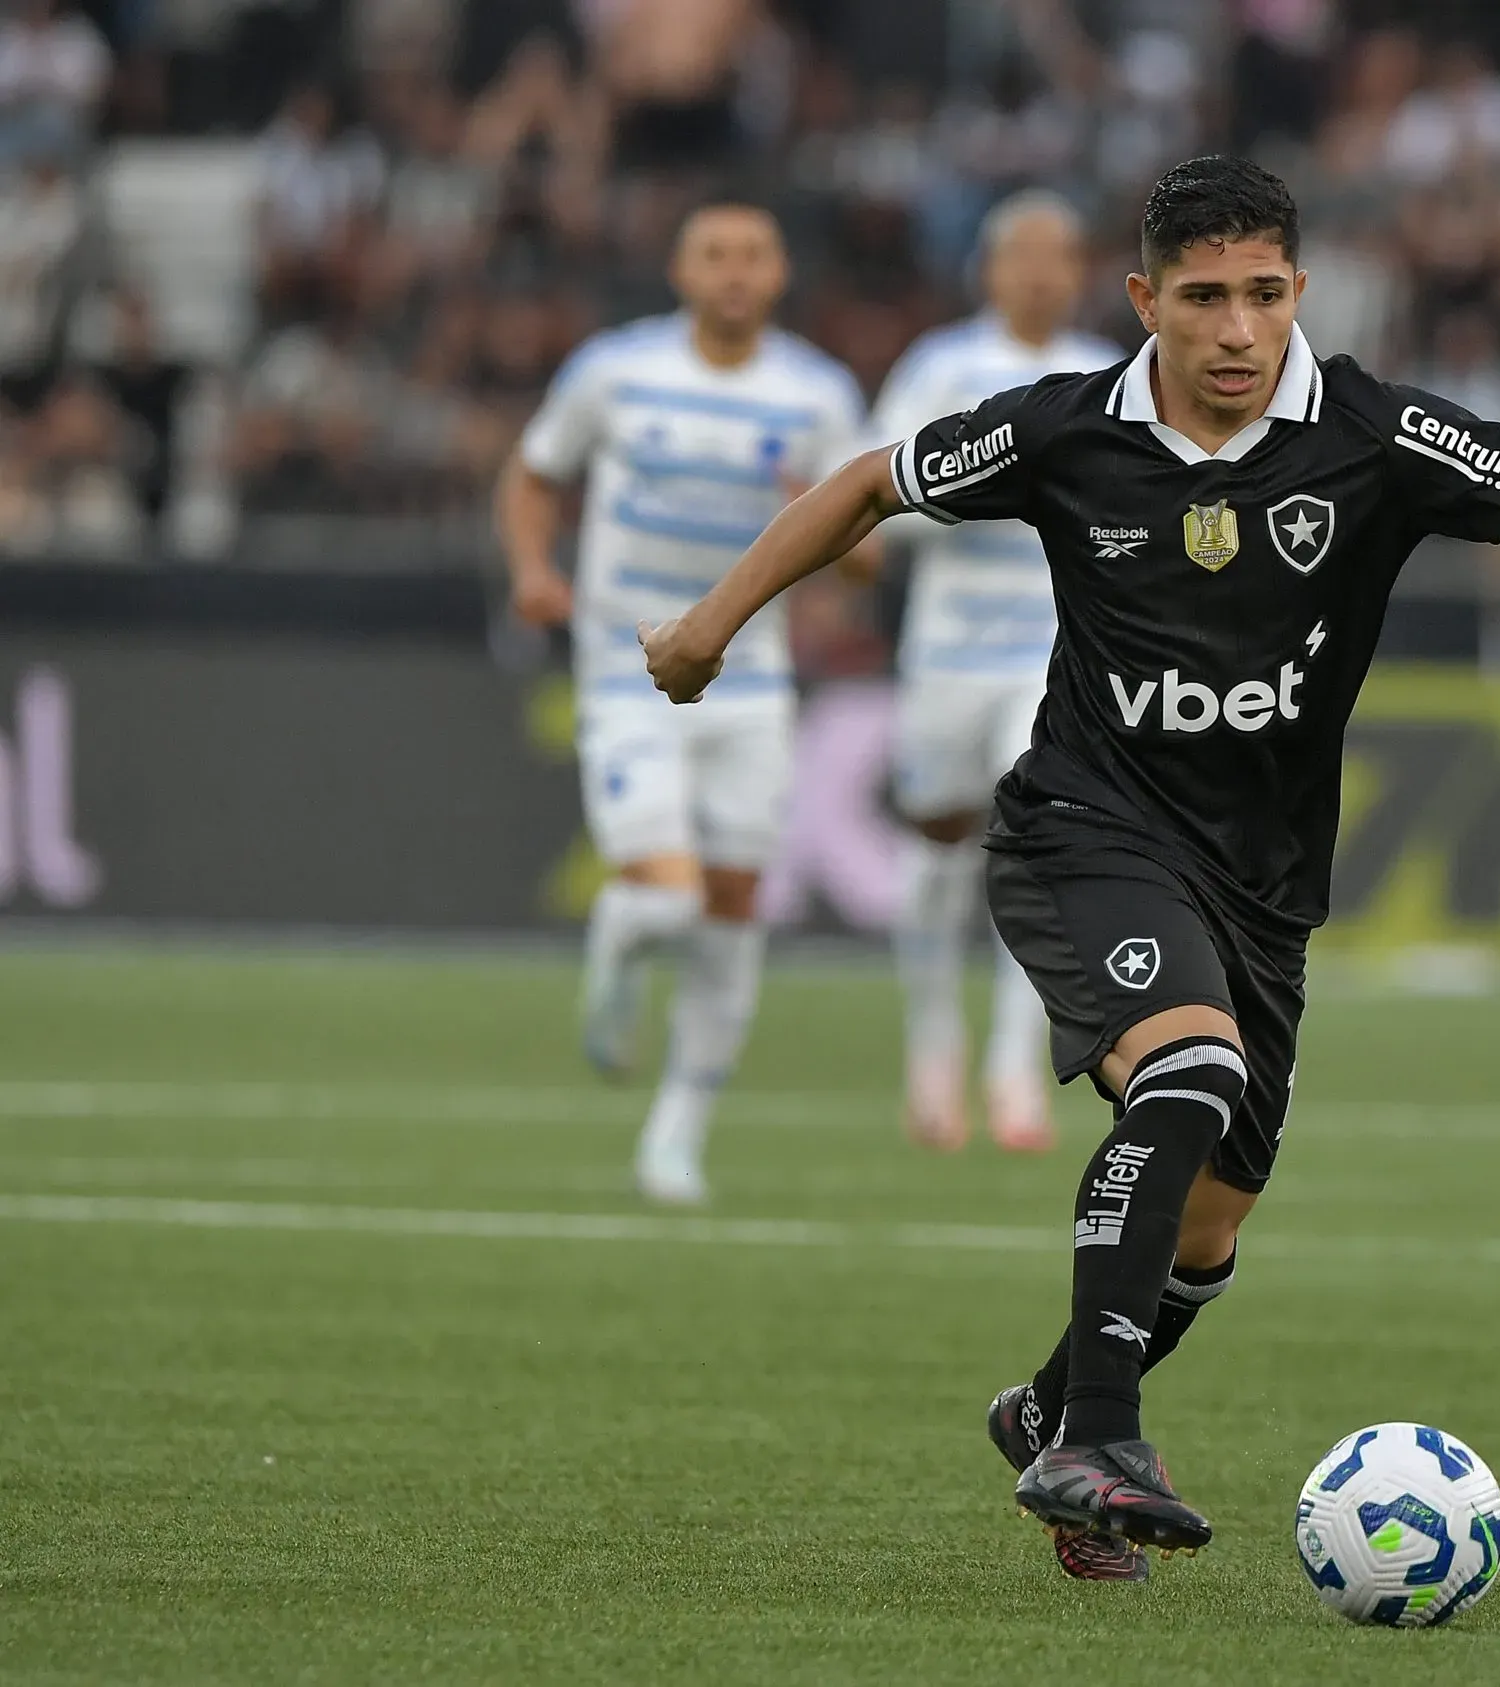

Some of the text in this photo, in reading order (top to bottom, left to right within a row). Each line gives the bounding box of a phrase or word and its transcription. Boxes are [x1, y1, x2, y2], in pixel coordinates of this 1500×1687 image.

[921, 423, 1014, 482] Centrum
[1089, 526, 1149, 540] Reebok
[1107, 660, 1305, 733] vbet
